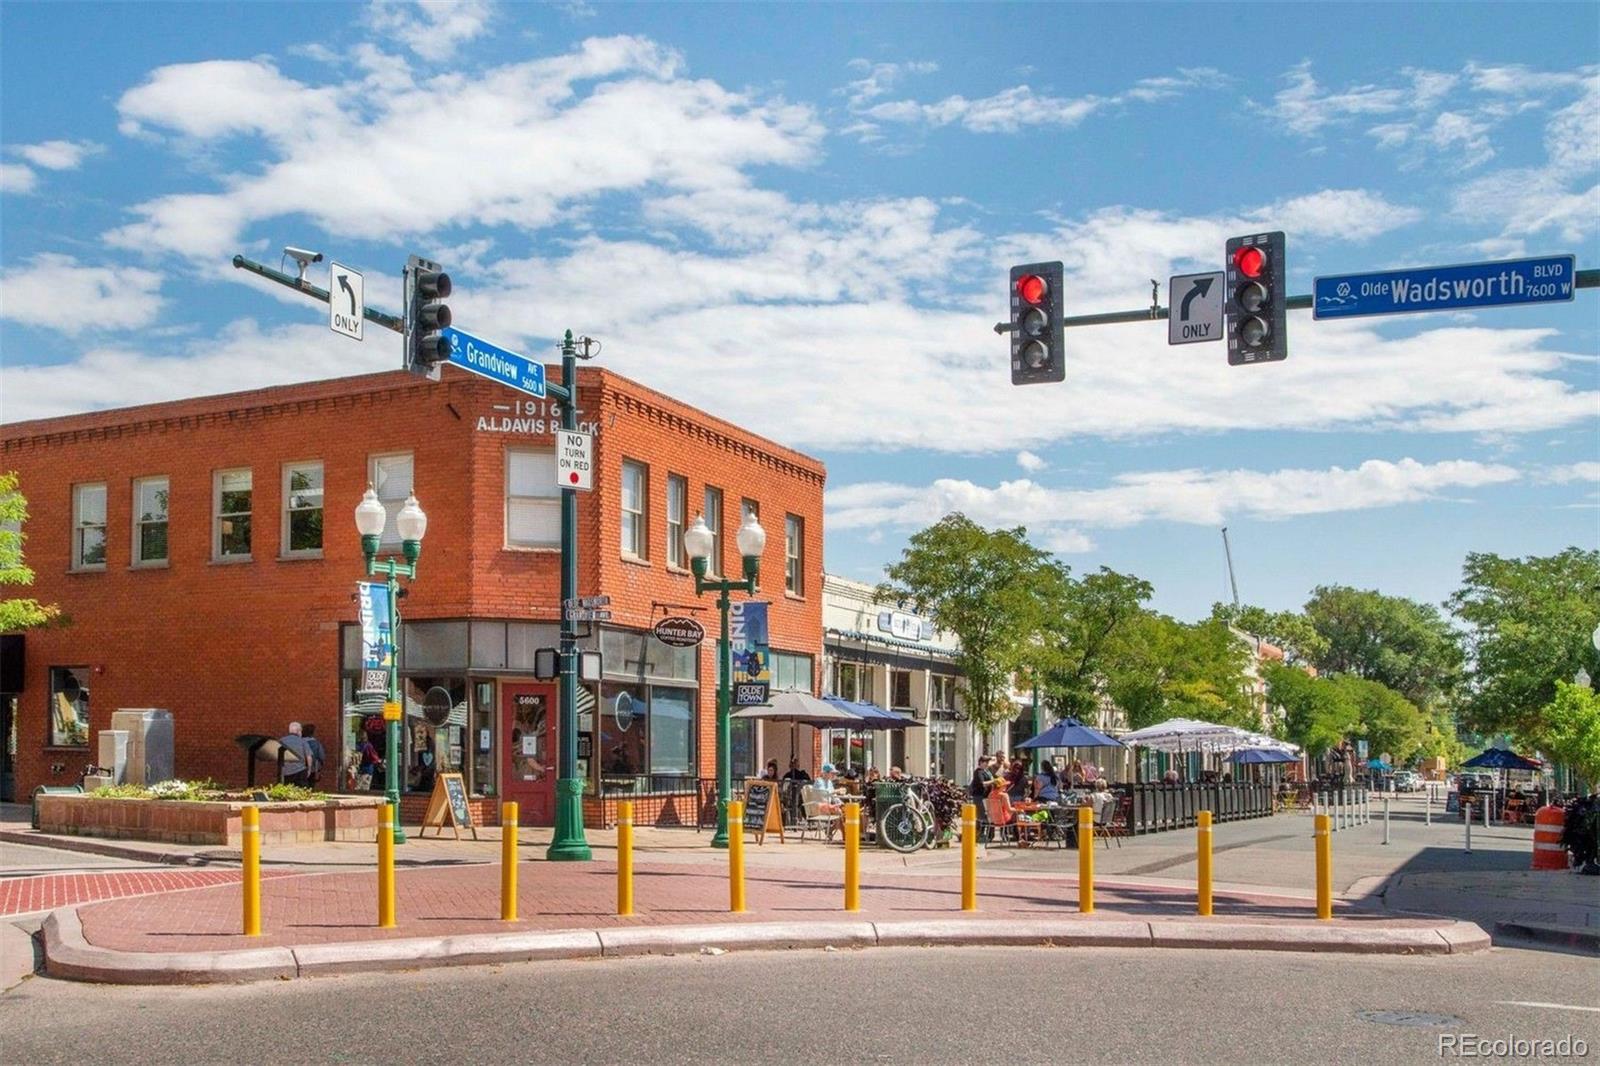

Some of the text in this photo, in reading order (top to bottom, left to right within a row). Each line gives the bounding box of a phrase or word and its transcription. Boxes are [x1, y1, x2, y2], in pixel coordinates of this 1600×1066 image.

[1533, 264, 1563, 278] BLVD
[1361, 270, 1524, 304] Olde Wadsworth
[1526, 282, 1571, 297] 7600 W
[334, 313, 360, 334] ONLY
[1182, 323, 1211, 339] ONLY
[466, 341, 518, 380] Grandview
[527, 362, 538, 376] AVE
[522, 376, 544, 394] 5600 N
[515, 400, 561, 417] 1916
[567, 435, 583, 447] NO
[564, 447, 586, 459] TURN
[560, 459, 590, 471] ON RED
[656, 626, 687, 637] HUNTER
[688, 629, 703, 640] BAY
[731, 602, 746, 652] DINE
[740, 686, 763, 695] OLDE
[519, 696, 540, 705] 5600
[739, 694, 762, 702] TOWN
